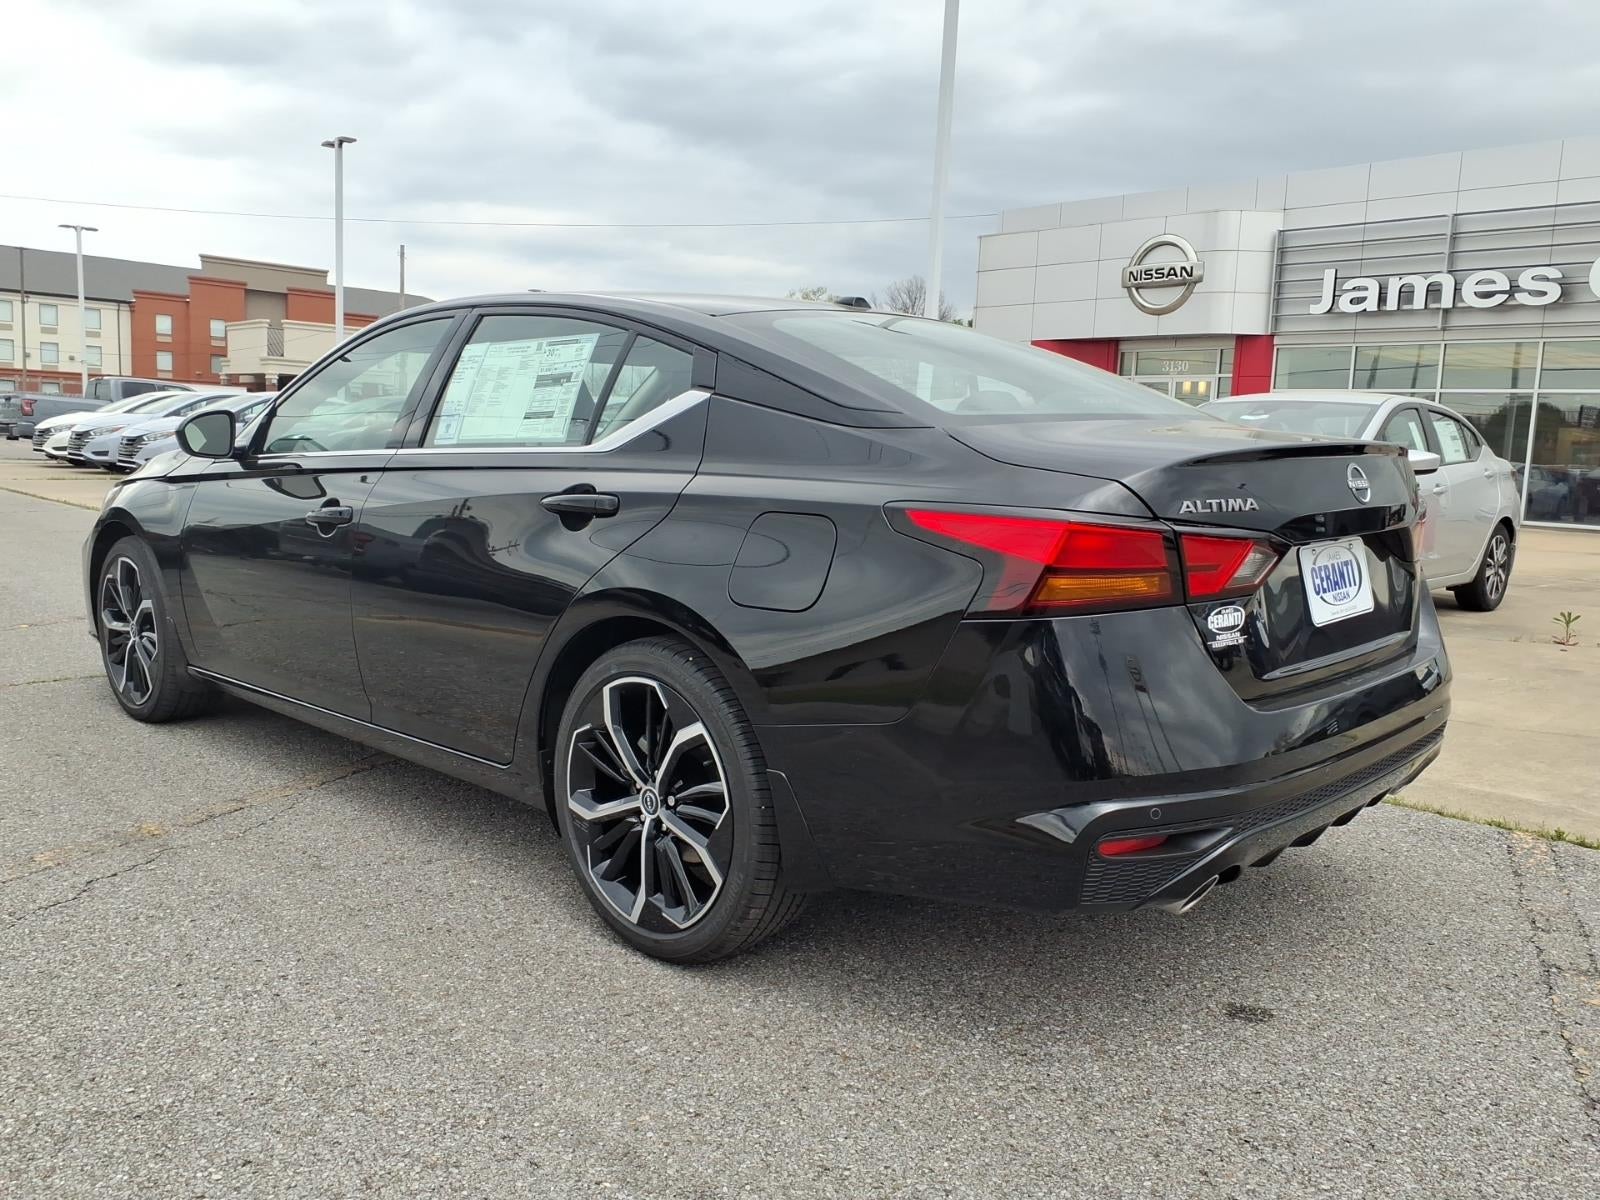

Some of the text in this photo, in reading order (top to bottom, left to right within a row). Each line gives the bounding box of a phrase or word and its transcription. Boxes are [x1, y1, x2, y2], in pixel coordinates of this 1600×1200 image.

[1128, 266, 1194, 282] NISSAN
[1309, 266, 1564, 315] James
[1161, 360, 1189, 372] 3130
[1179, 498, 1260, 514] ALTIMA
[1311, 559, 1357, 596] CERANTI
[1333, 590, 1351, 603] NISSAN
[1207, 612, 1242, 630] CERANTI
